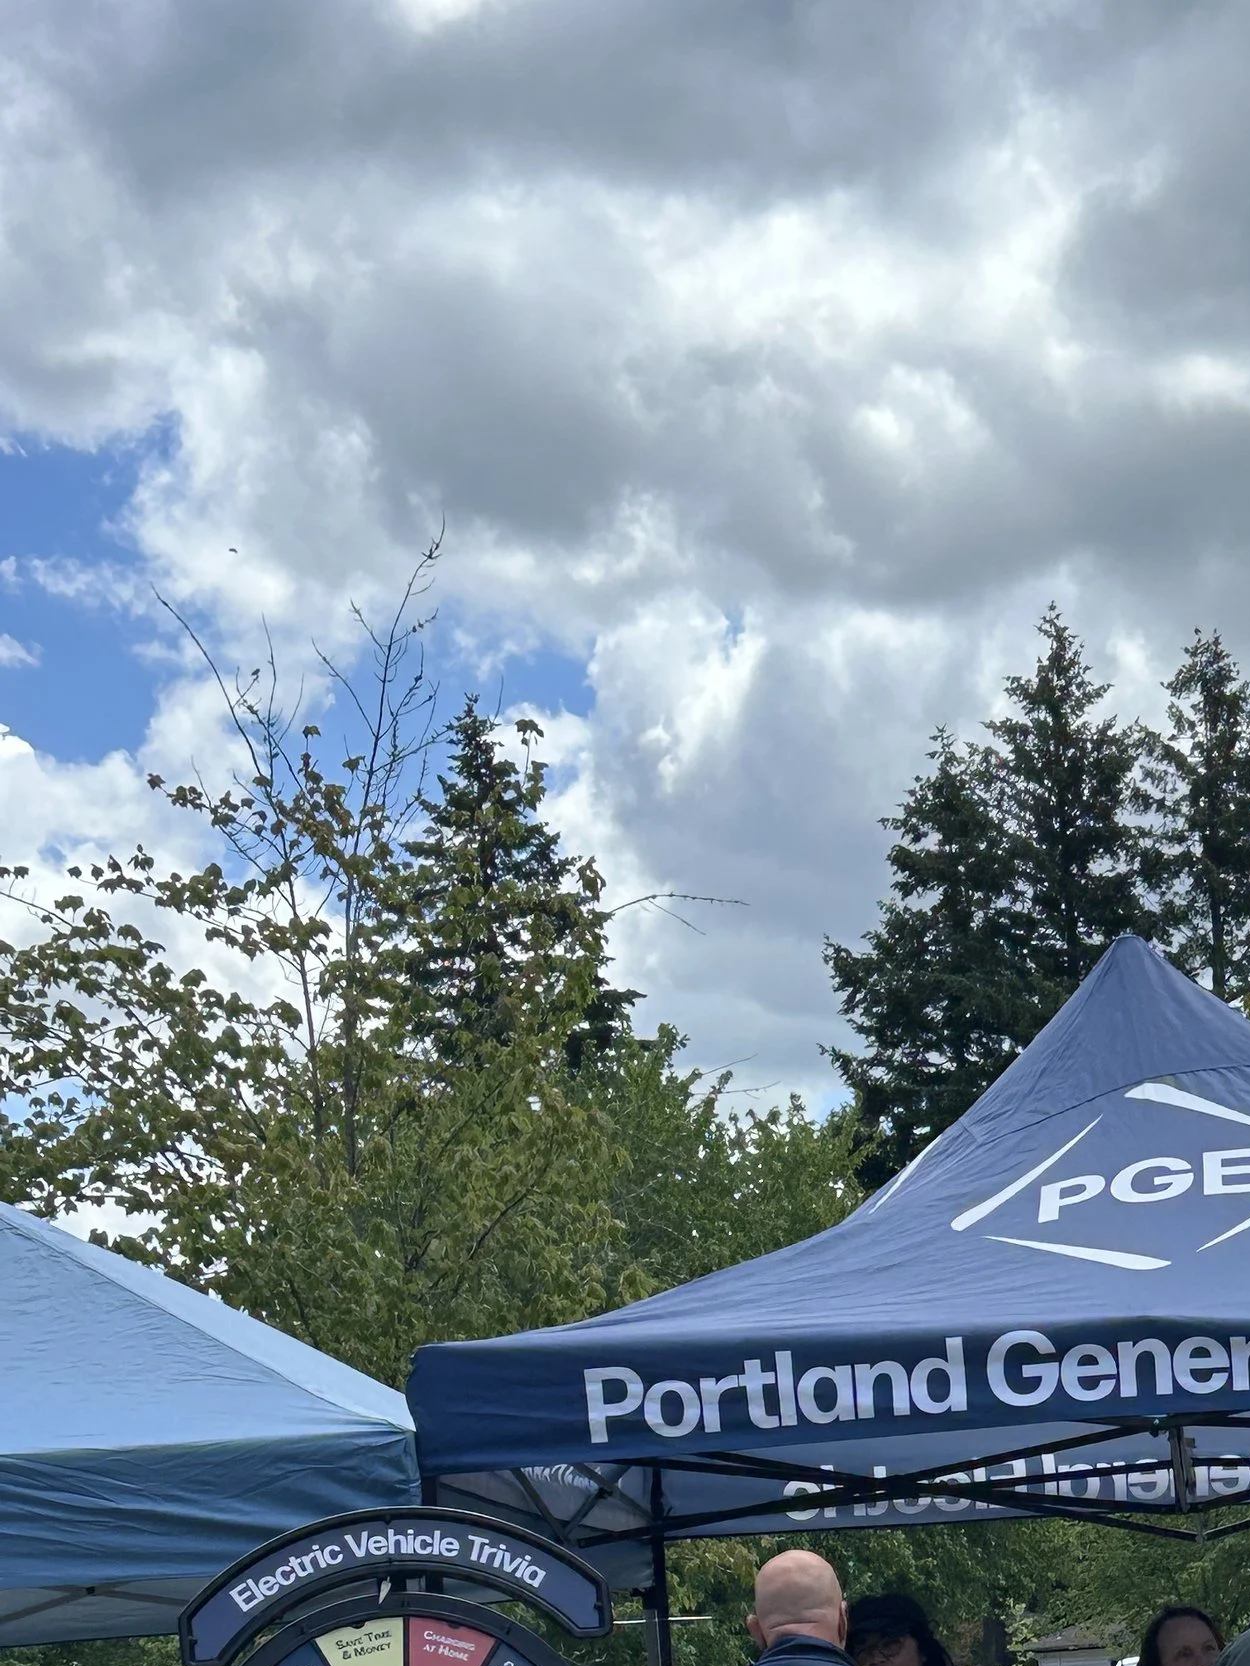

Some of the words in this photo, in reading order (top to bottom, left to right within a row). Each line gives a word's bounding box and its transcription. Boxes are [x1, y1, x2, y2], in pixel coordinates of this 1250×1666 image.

[584, 1336, 968, 1444] Portland
[229, 1543, 344, 1612] Electric
[343, 1528, 460, 1558] Vehicle
[467, 1535, 548, 1589] Trivia
